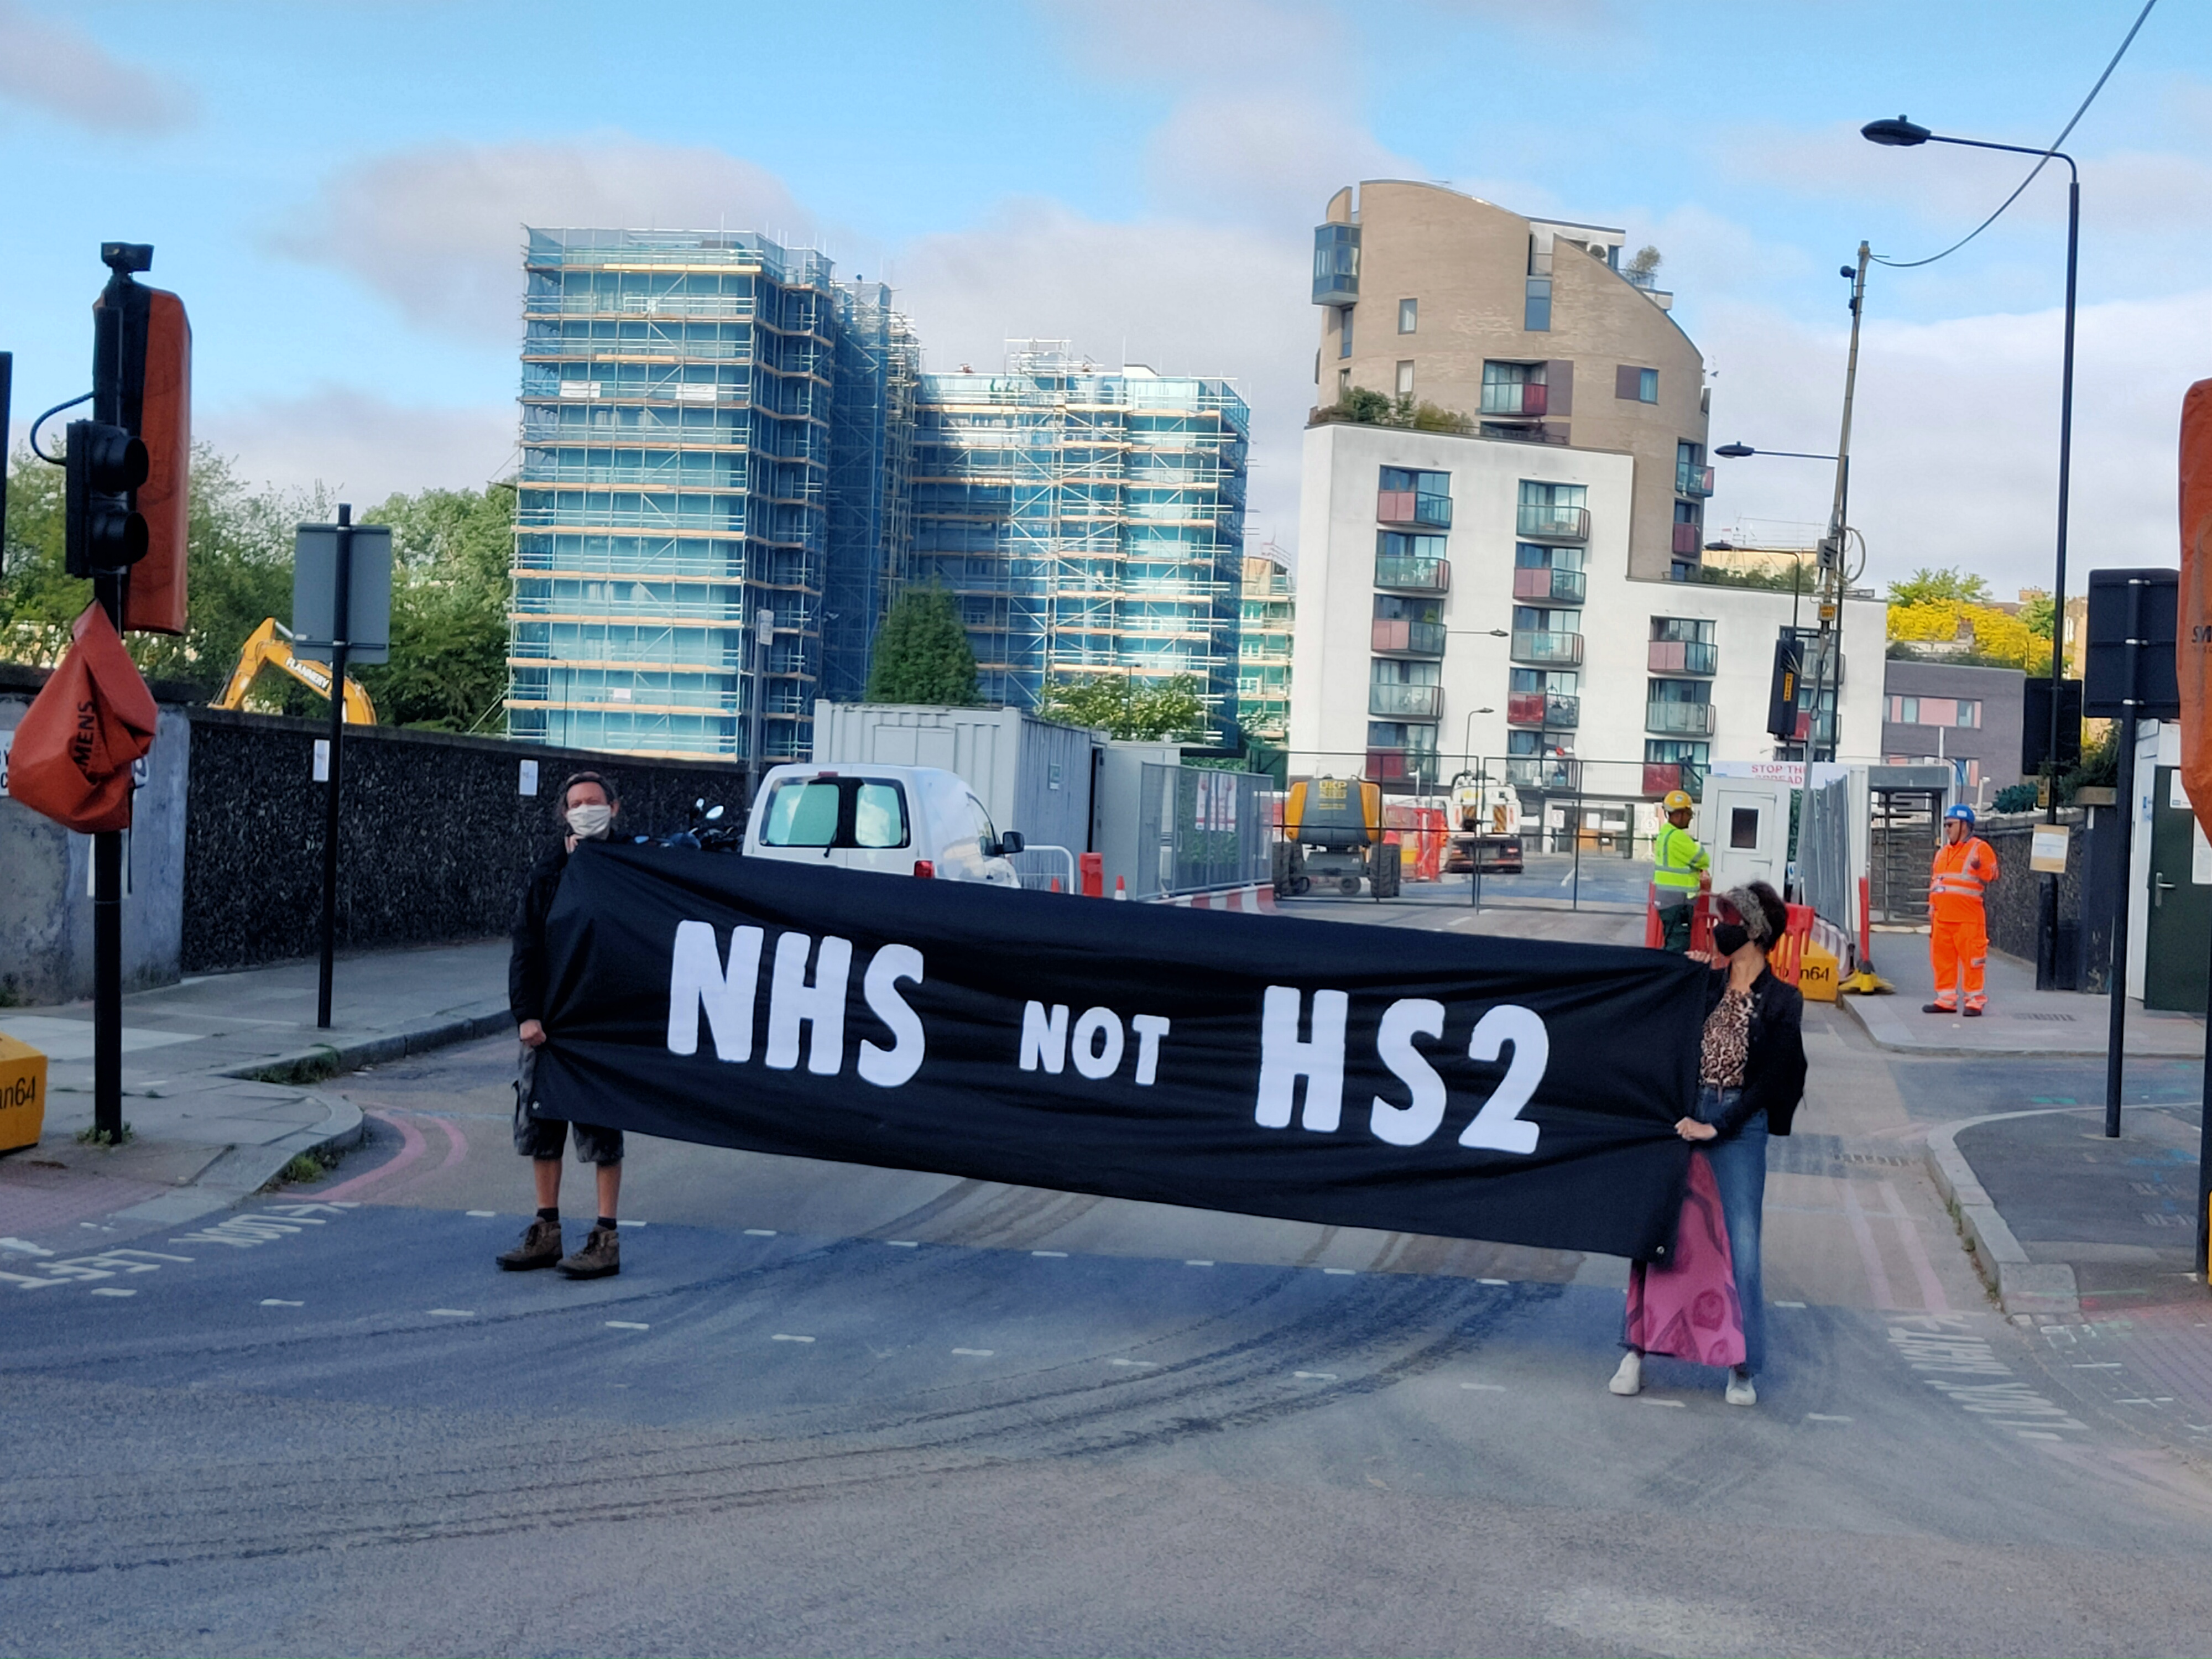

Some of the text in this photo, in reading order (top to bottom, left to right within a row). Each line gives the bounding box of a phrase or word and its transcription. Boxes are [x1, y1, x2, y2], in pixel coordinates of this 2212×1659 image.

[1751, 765, 1806, 774] STOP TH
[668, 920, 1549, 1154] NHS NOT HS2
[0, 1076, 35, 1109] n64
[0, 1214, 327, 1289] LOOK LEFT
[1887, 1327, 2090, 1431] LOOK RIGHT
